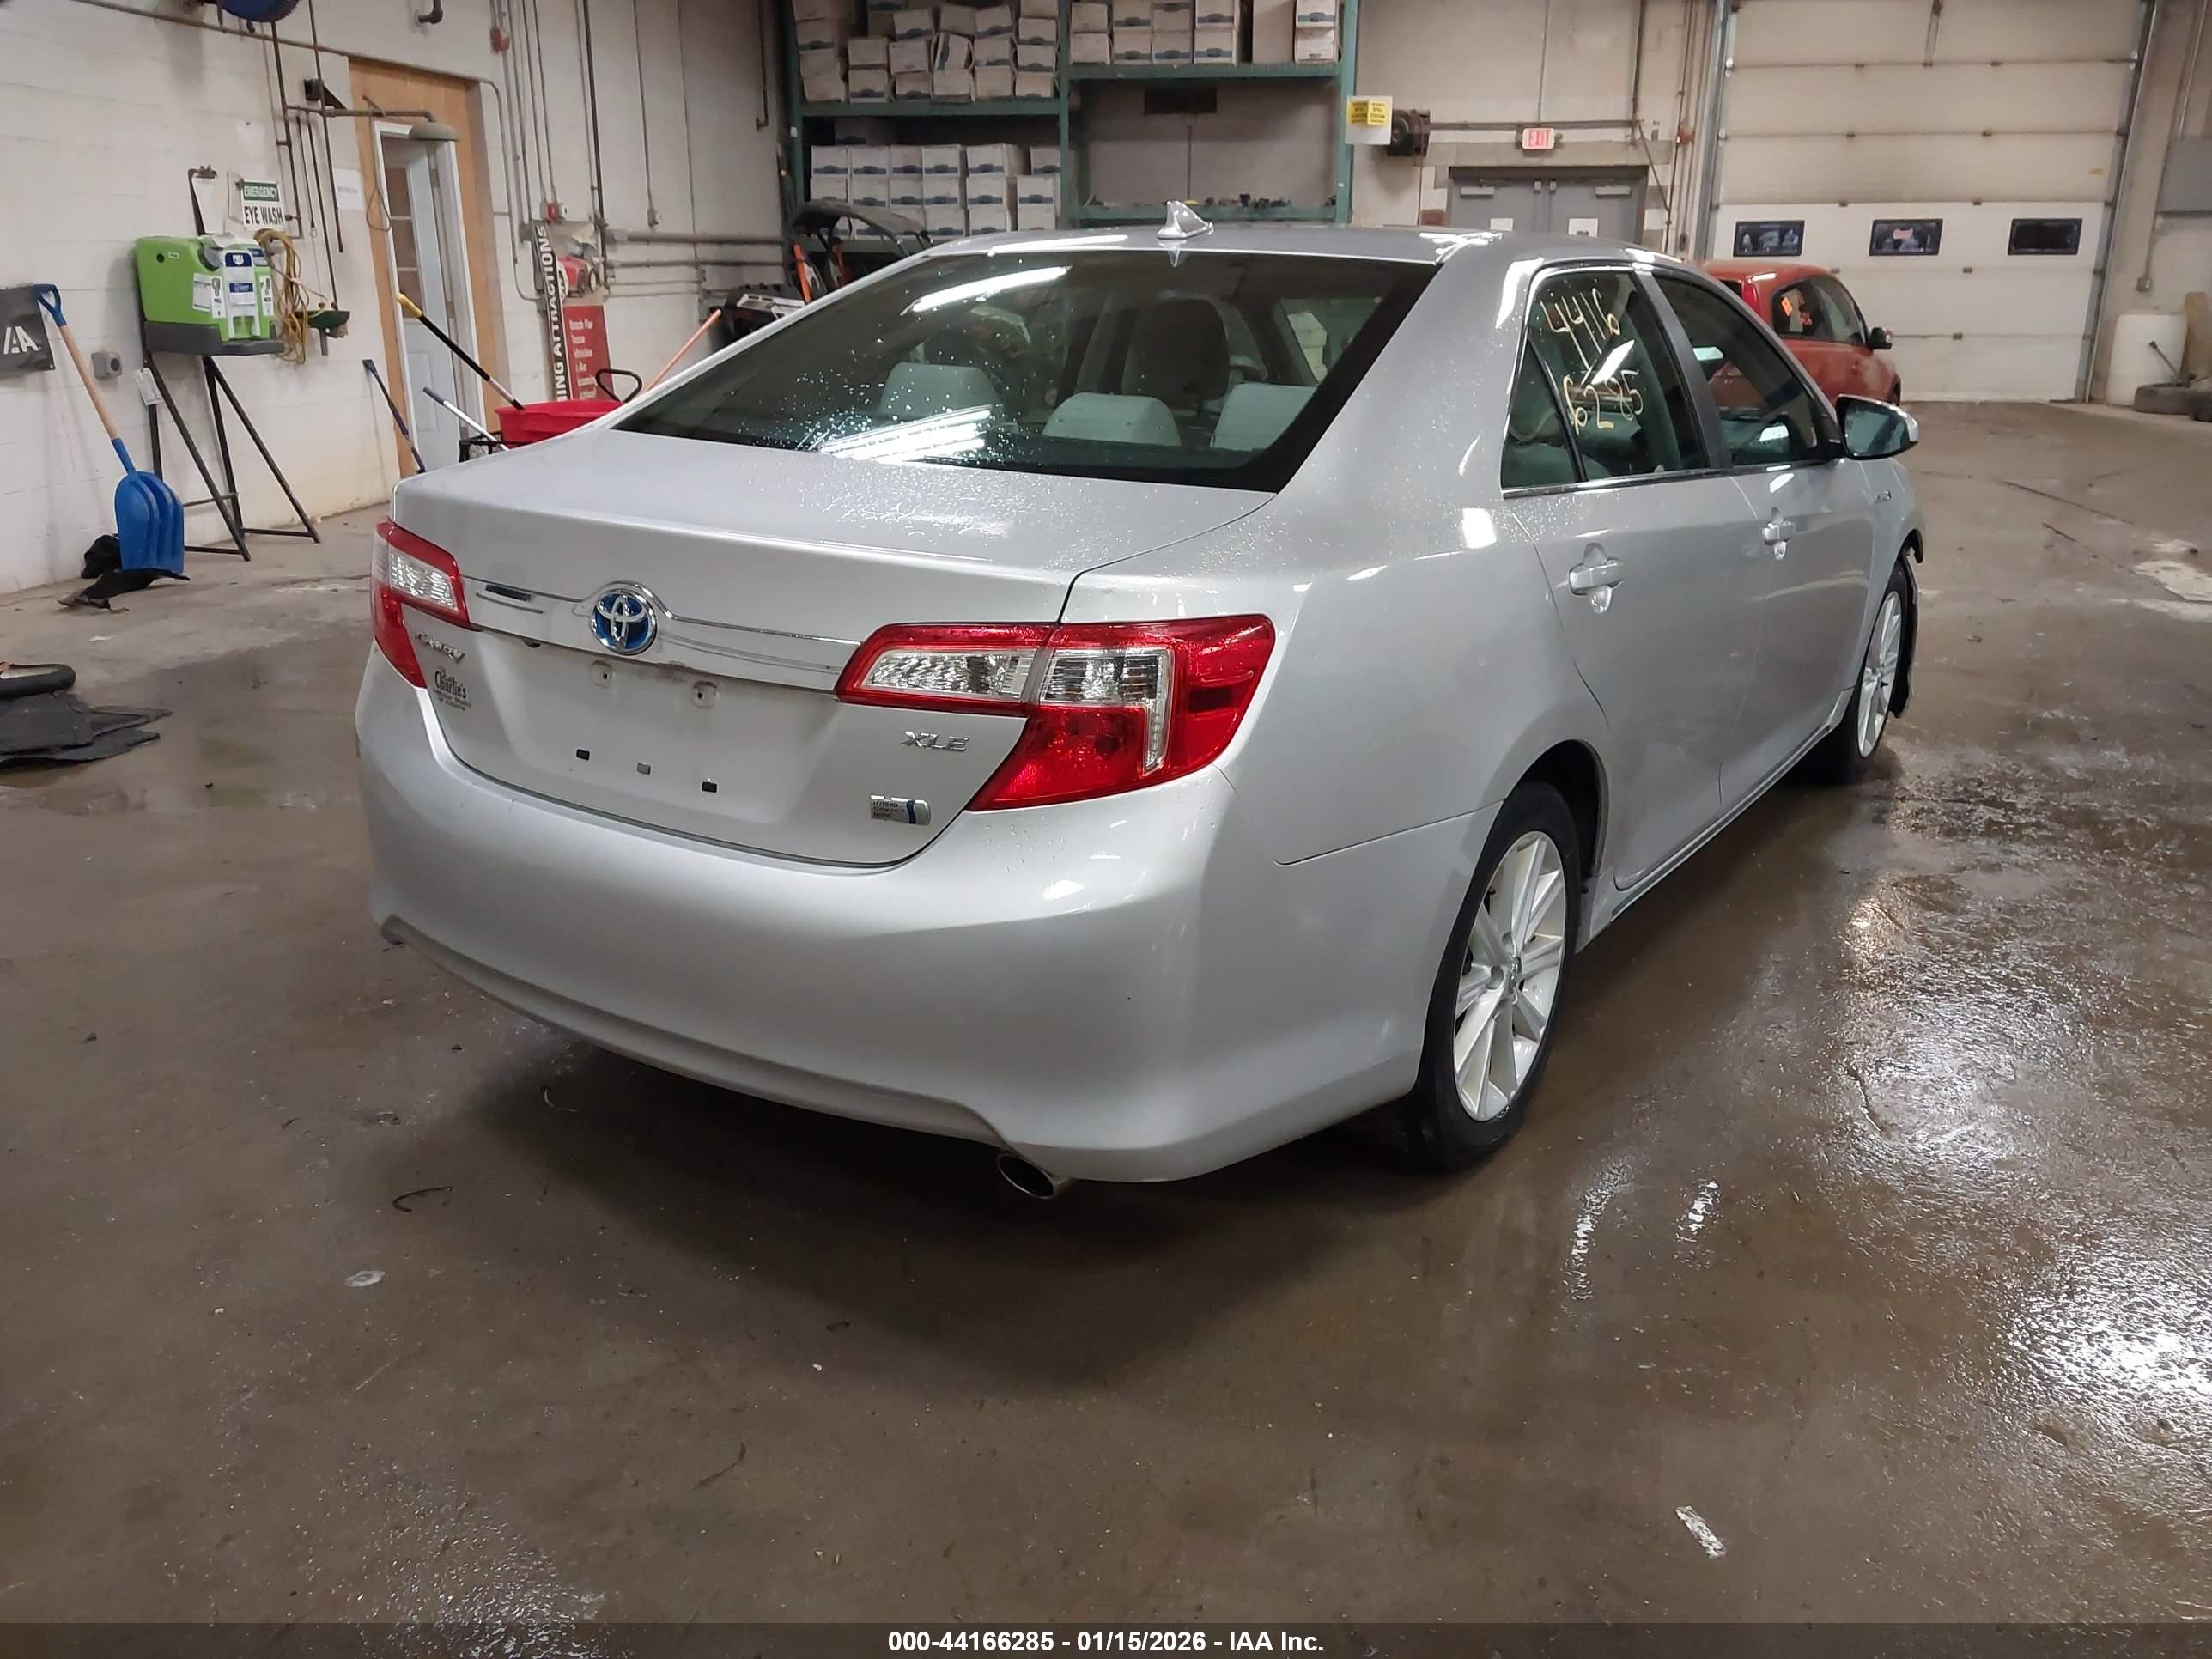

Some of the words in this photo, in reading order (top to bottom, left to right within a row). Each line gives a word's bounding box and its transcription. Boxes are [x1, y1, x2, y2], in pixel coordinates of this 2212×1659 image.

[1528, 129, 1552, 147] EXIT
[245, 185, 277, 198] EMERGENCY
[244, 205, 258, 225] EYE
[259, 206, 284, 226] WASH
[536, 224, 564, 357] ATTRACTIONS
[1563, 368, 1644, 435] 6285
[899, 730, 969, 752] XLE
